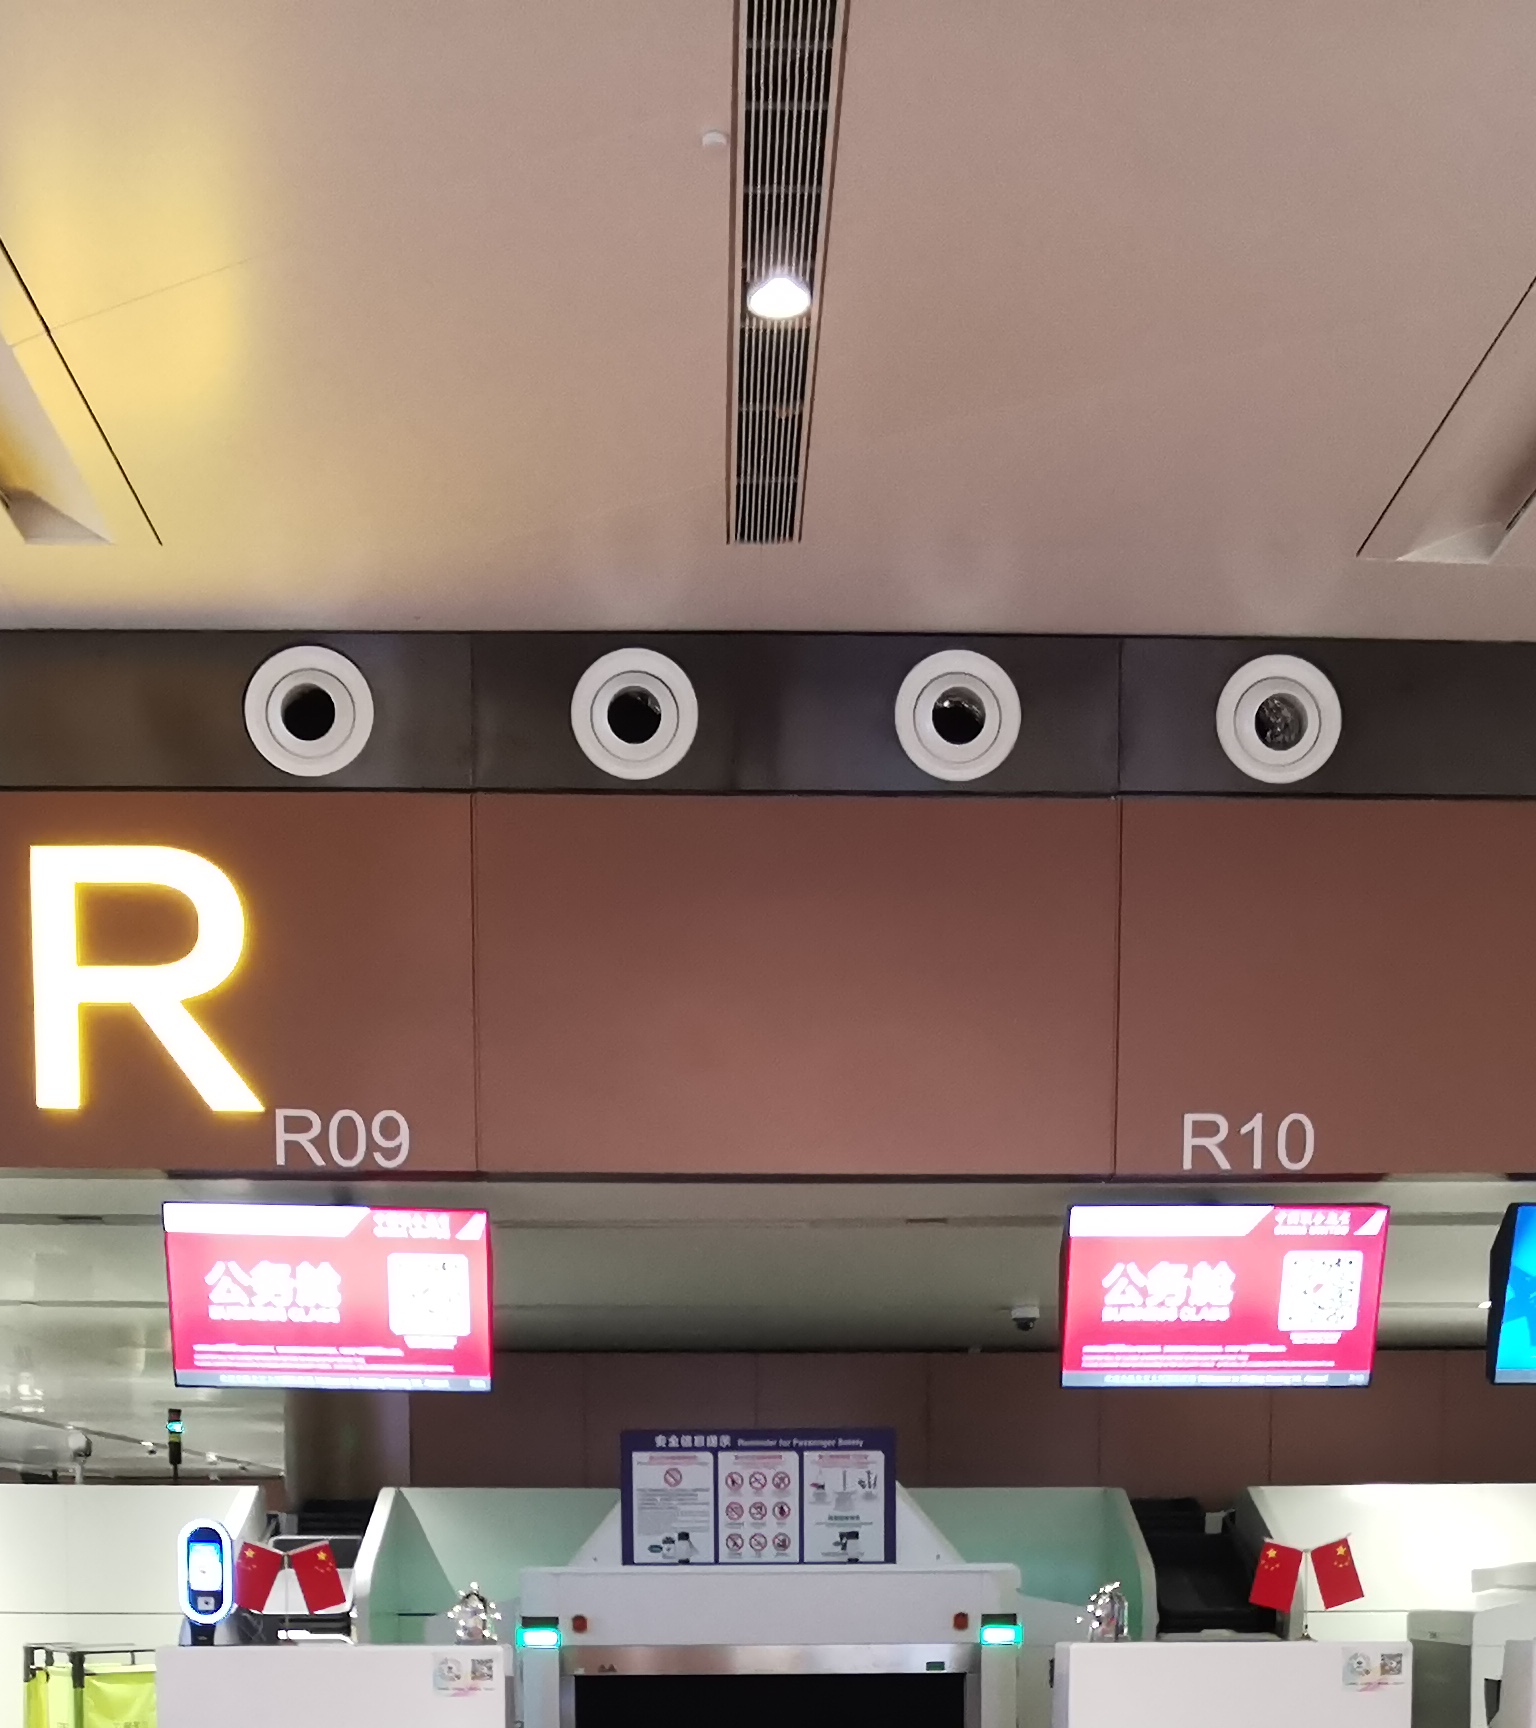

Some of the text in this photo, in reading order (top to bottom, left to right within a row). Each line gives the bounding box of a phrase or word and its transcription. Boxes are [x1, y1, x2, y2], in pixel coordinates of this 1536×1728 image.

[30, 845, 265, 1112] R
[275, 1108, 410, 1168] R09
[1182, 1112, 1315, 1171] R10
